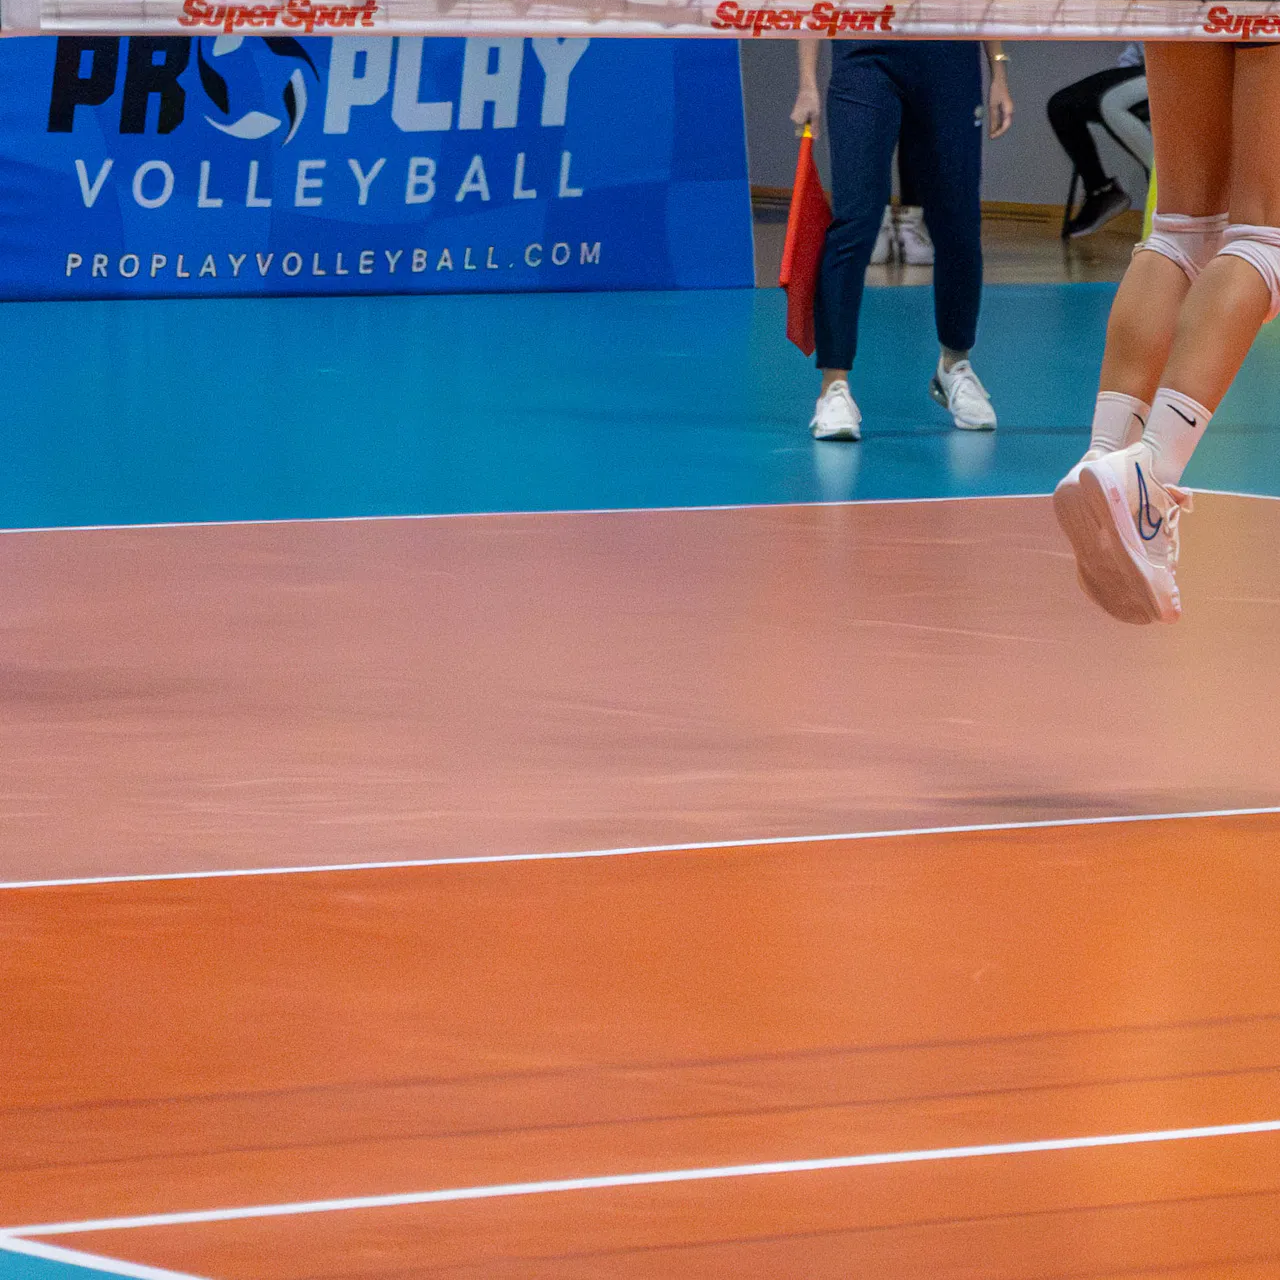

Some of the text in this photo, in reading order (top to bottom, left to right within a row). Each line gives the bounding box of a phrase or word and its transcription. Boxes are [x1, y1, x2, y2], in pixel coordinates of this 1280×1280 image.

[711, 0, 896, 36] SuperSport
[74, 150, 586, 209] VOLLEYBALL
[65, 241, 603, 279] PROPLAYVOLLEYBALL.COM
